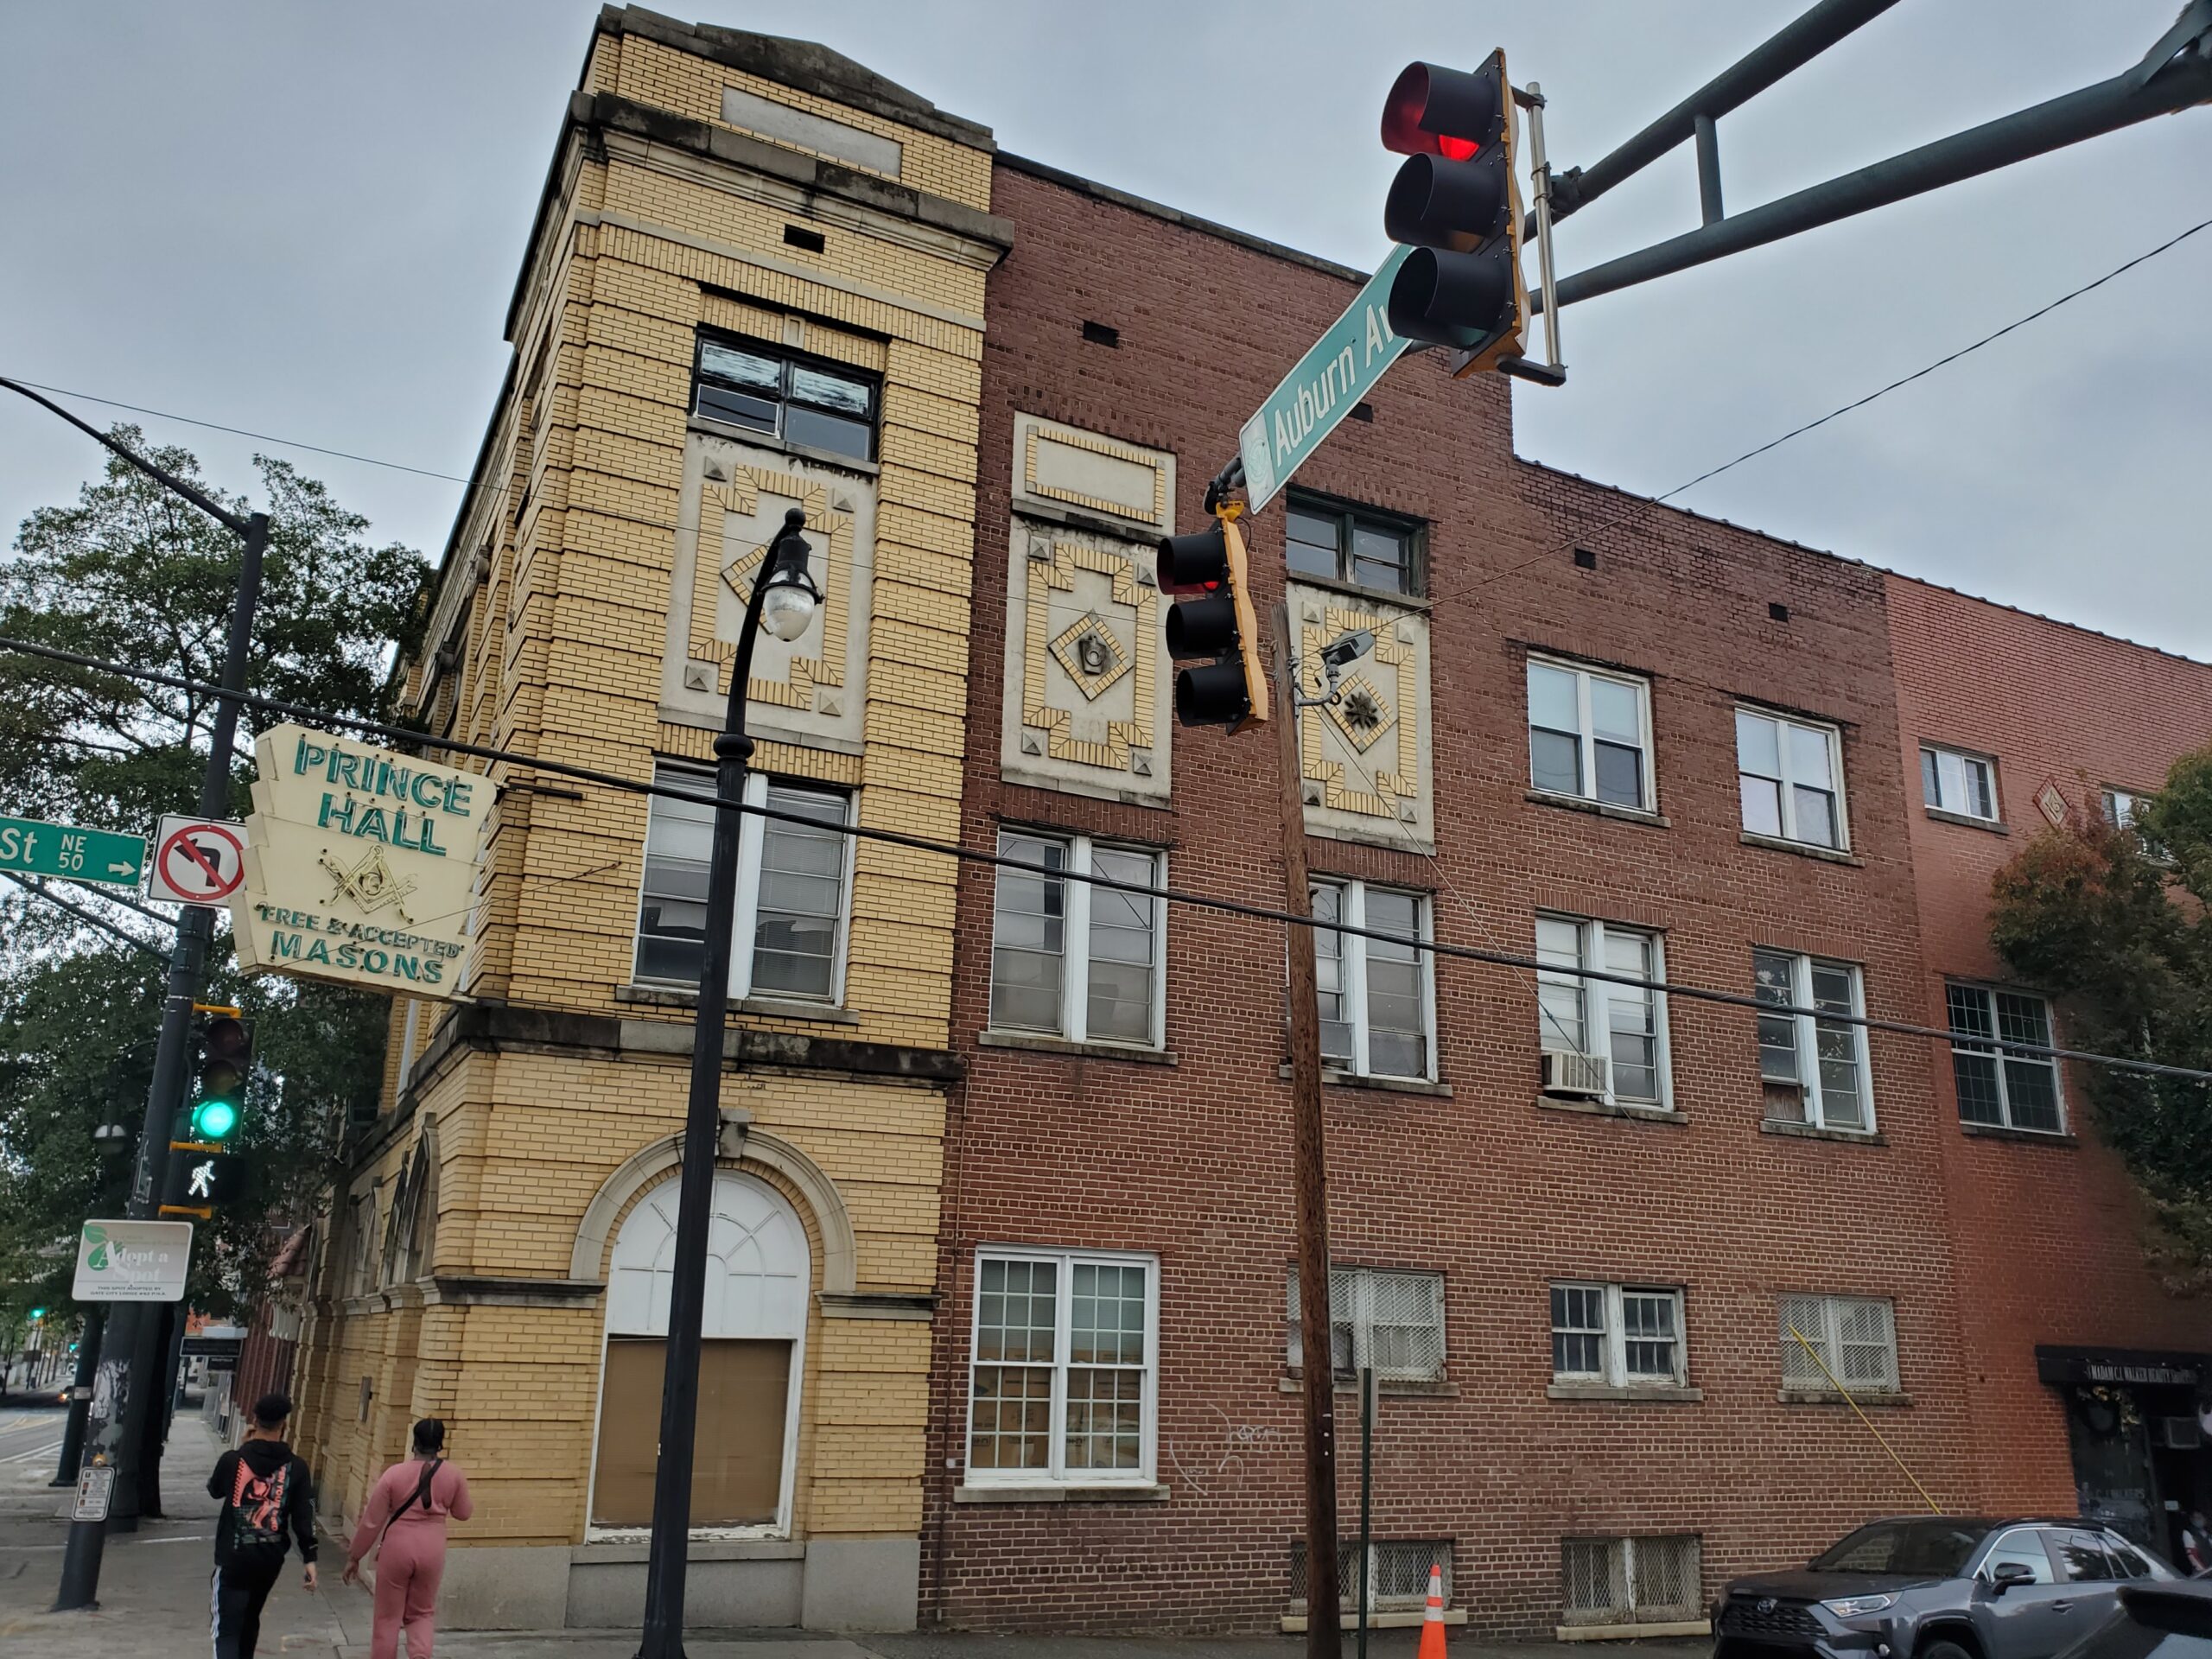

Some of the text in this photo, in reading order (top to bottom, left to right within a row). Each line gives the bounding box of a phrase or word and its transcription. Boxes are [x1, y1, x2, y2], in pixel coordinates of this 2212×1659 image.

[1274, 345, 1356, 467] Auburn
[294, 738, 473, 817] PRINCE
[0, 828, 87, 864] St NE
[317, 792, 447, 856] HALL
[58, 852, 84, 871] 50
[260, 906, 461, 958] FREE & ACCEPTED
[270, 930, 445, 983] MASONS
[92, 1241, 168, 1268] Adopt a
[113, 1263, 161, 1284] Spot
[2091, 1364, 2113, 1381] MADAM
